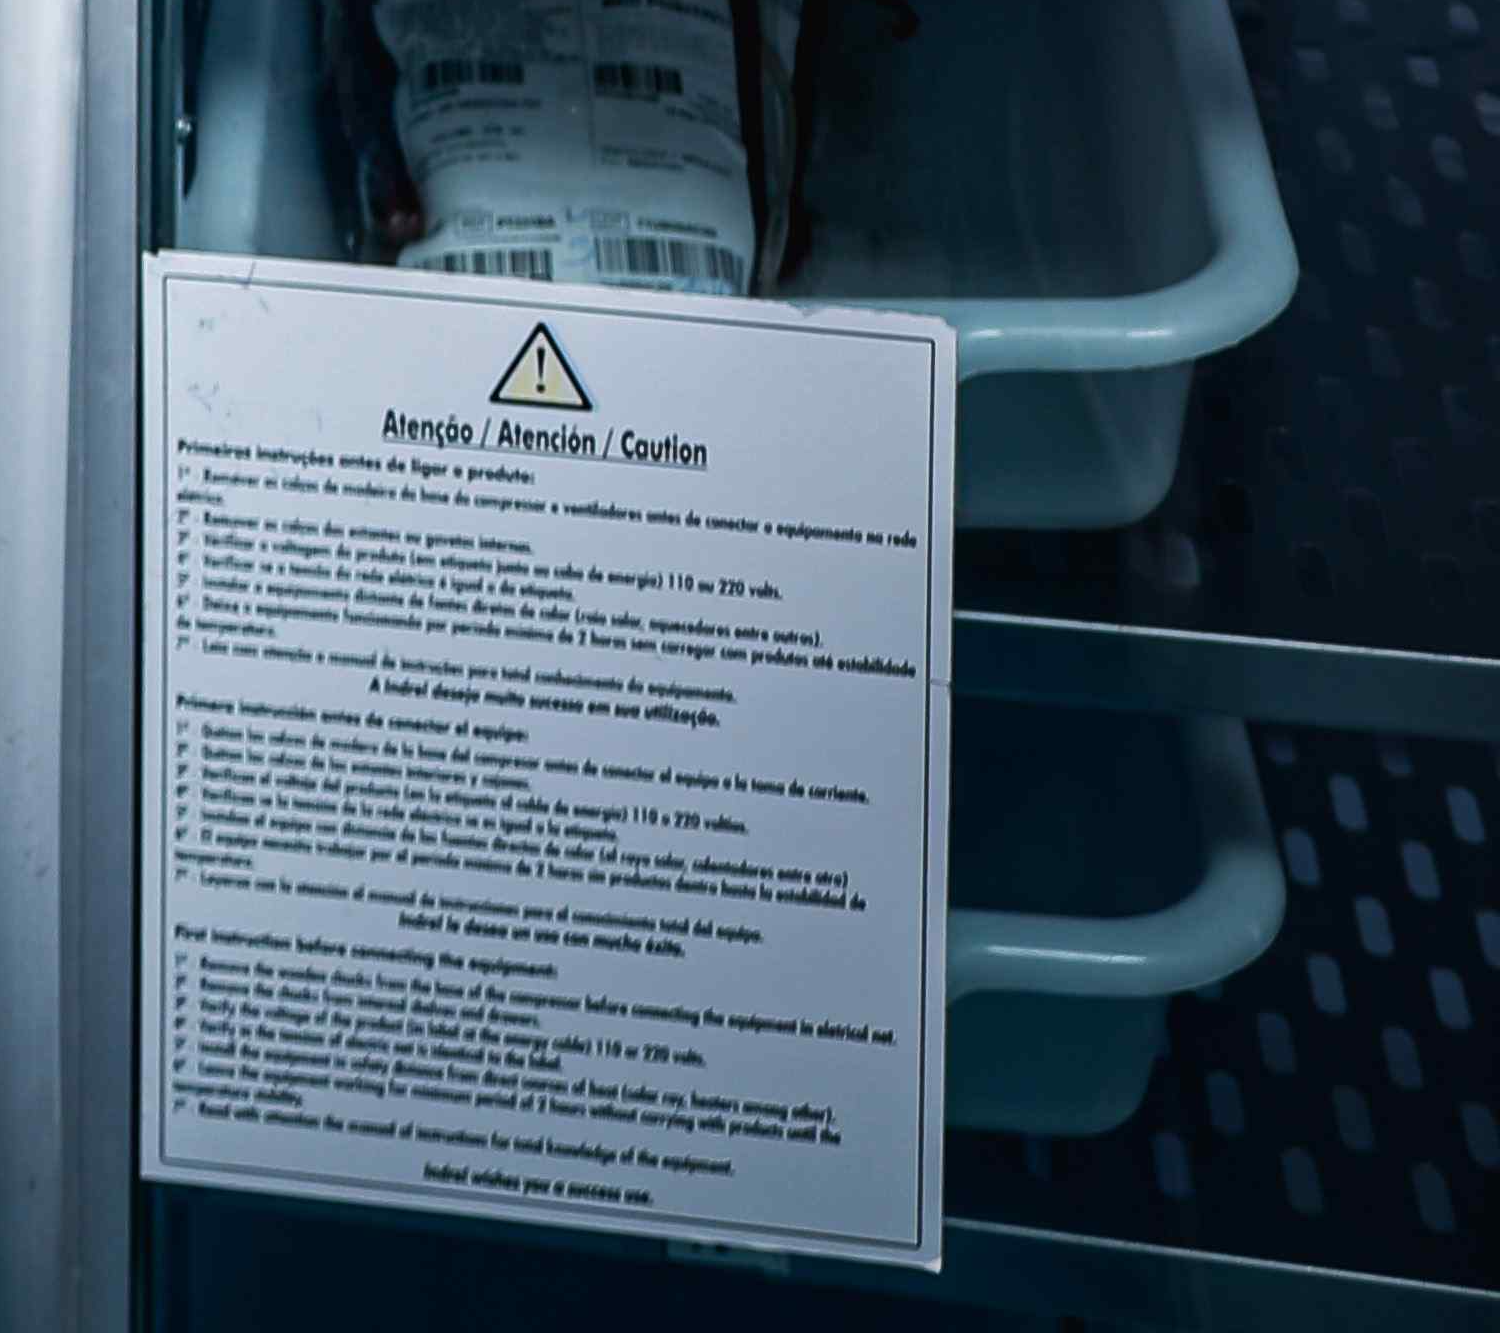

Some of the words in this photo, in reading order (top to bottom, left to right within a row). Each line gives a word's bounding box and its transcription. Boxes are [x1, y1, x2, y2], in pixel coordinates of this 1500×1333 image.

[383, 407, 473, 450] Atenção
[497, 417, 595, 455] Atención
[621, 427, 707, 464] Caution
